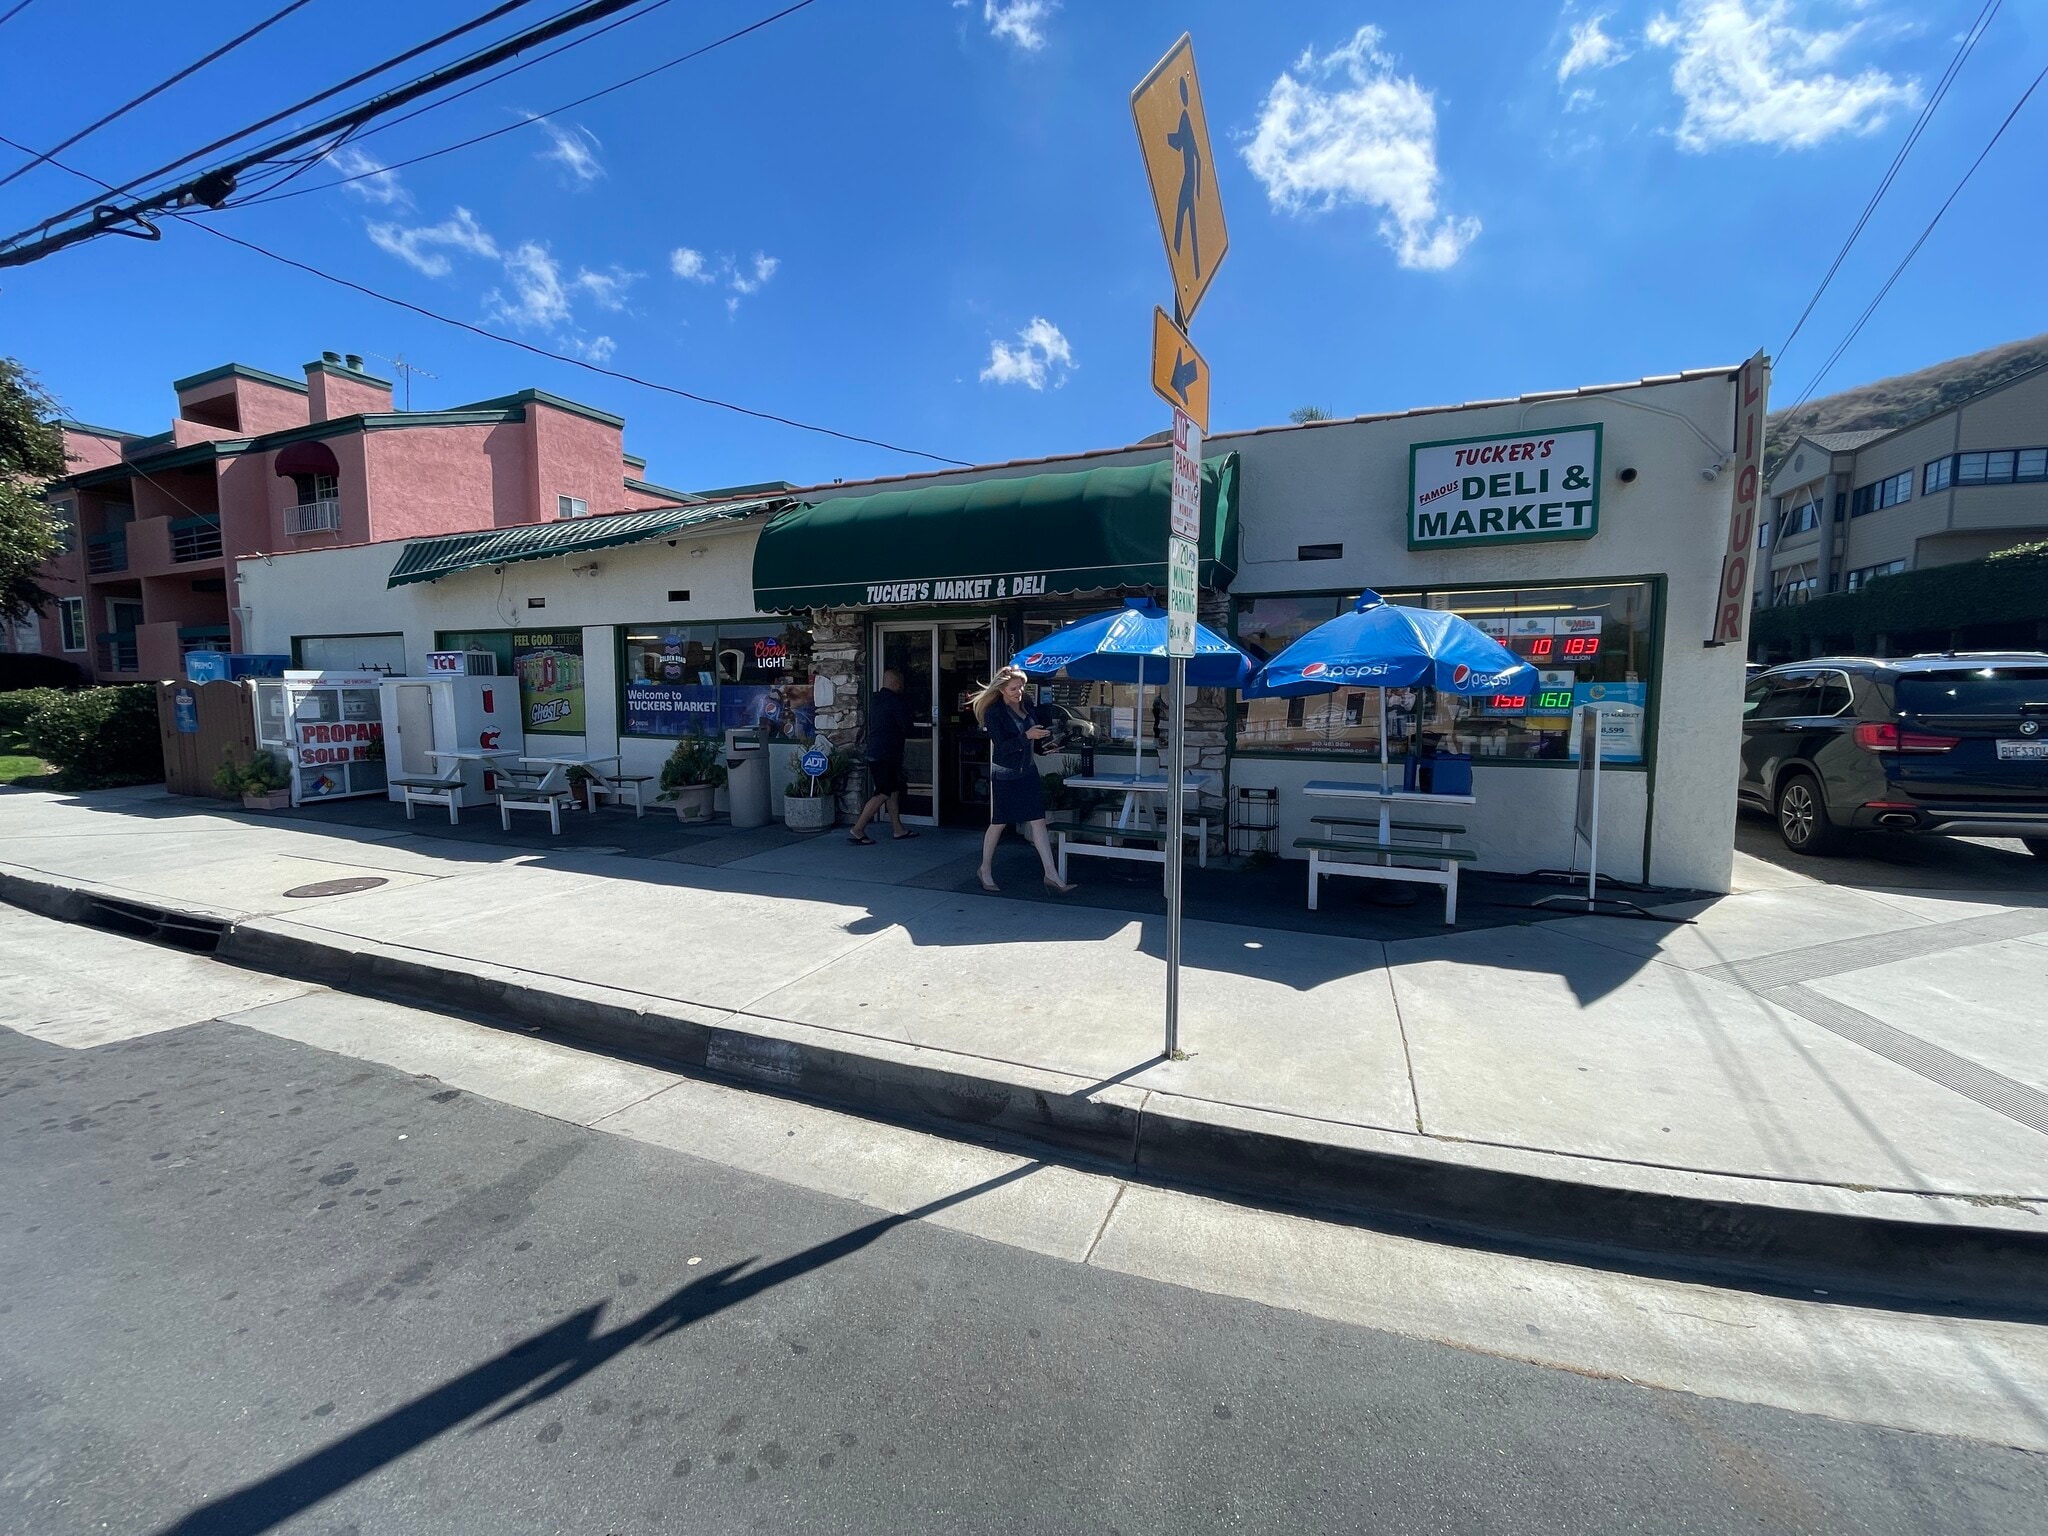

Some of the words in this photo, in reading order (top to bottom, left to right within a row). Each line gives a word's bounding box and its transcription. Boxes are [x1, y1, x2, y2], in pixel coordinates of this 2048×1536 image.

[1176, 413, 1187, 446] NO
[1455, 439, 1555, 467] TUCKER'S
[1175, 451, 1199, 484] PARKING
[1419, 480, 1459, 504] FAMOUS
[1462, 468, 1549, 501] DELI
[1562, 465, 1591, 490] &
[1719, 364, 1759, 640] LIQUOR
[1419, 500, 1593, 538] MARKET
[1180, 543, 1189, 566] 20
[866, 582, 930, 603] TUCKER'S
[933, 579, 992, 600] MARKET
[996, 578, 1006, 597] &
[1012, 575, 1047, 595] DELI
[1173, 565, 1194, 592] MINUTE
[1171, 589, 1195, 615] PARKING
[514, 634, 530, 647] FEEL
[531, 634, 553, 646] GOOD
[554, 633, 582, 646] ENERG
[754, 640, 788, 658] Coors
[1564, 638, 1600, 655] 183
[433, 655, 456, 671] ICE
[757, 656, 787, 669] LIGHT
[1039, 654, 1073, 667] pepsi
[1328, 663, 1389, 678] pepsi
[627, 689, 670, 701] Welcome
[671, 690, 682, 700] to
[1539, 692, 1572, 708] 160
[531, 698, 563, 726] GHOST
[629, 701, 673, 711] TUCKERS
[674, 702, 717, 712] MARKET
[302, 722, 383, 744] PROPAN
[302, 747, 350, 764] SOLD
[1436, 735, 1507, 756] ATM
[804, 757, 826, 768] ADT
